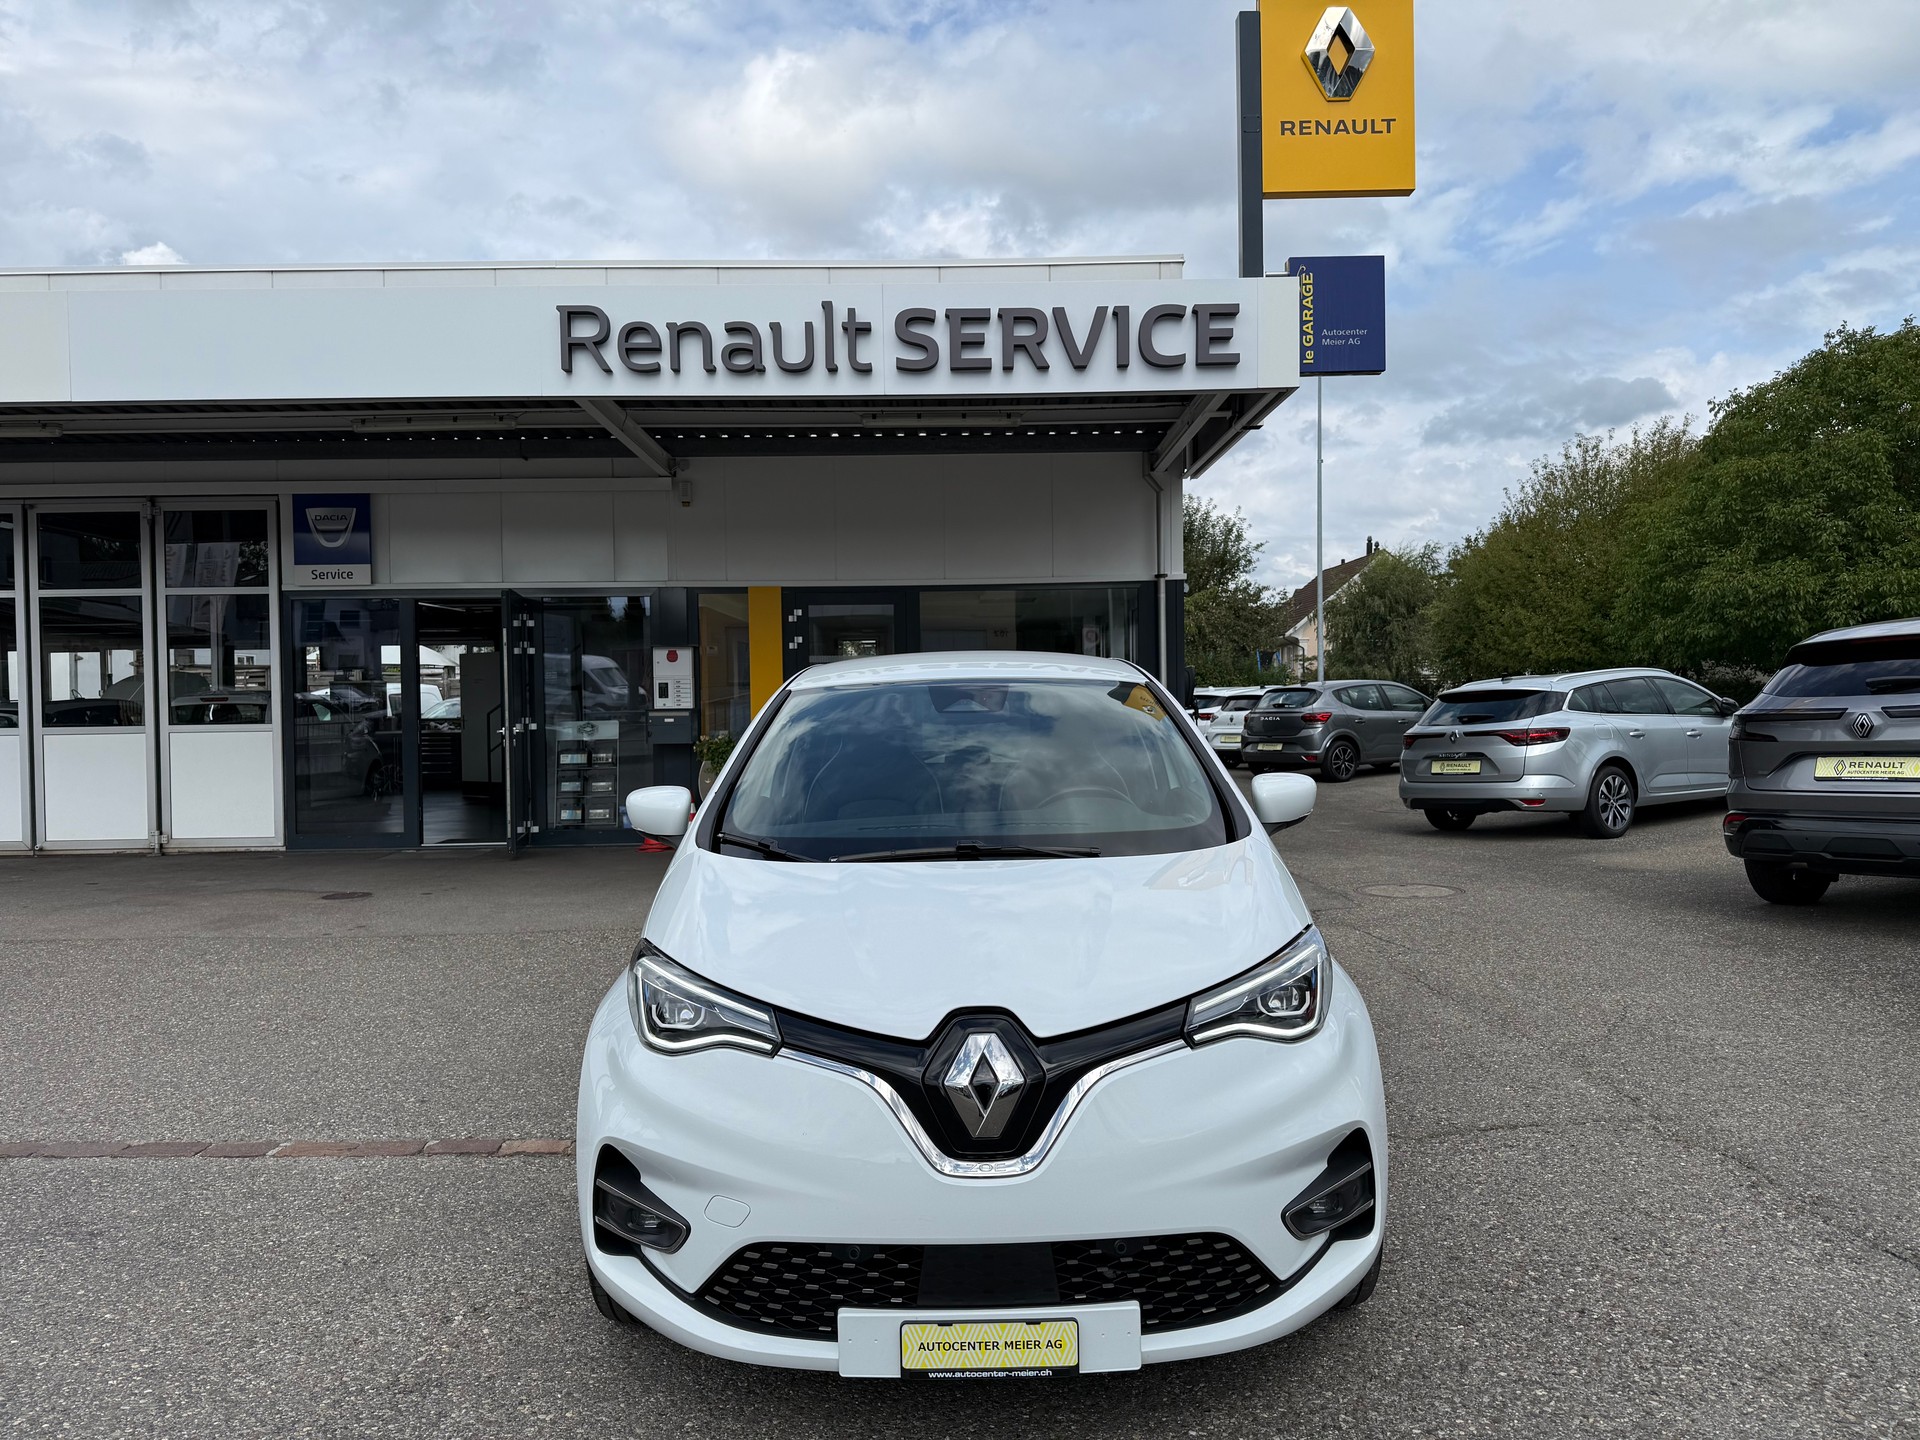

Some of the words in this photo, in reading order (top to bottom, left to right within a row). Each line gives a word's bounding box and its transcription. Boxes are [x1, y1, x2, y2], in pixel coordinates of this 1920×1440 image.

[1280, 118, 1396, 136] RENAULT
[1302, 272, 1314, 347] GARAGE
[556, 300, 873, 374] Renault
[894, 303, 1241, 372] SERVICE
[1321, 338, 1346, 346] Meier
[1347, 337, 1361, 345] AG
[1303, 350, 1314, 364] le
[311, 569, 354, 580] Service
[966, 1162, 1008, 1173] ZOE
[918, 1341, 1000, 1352] AUTOCENTER
[1004, 1340, 1042, 1350] MEIER
[1045, 1339, 1063, 1349] AG
[928, 1369, 1053, 1379] www.autocenter-meier.ch
